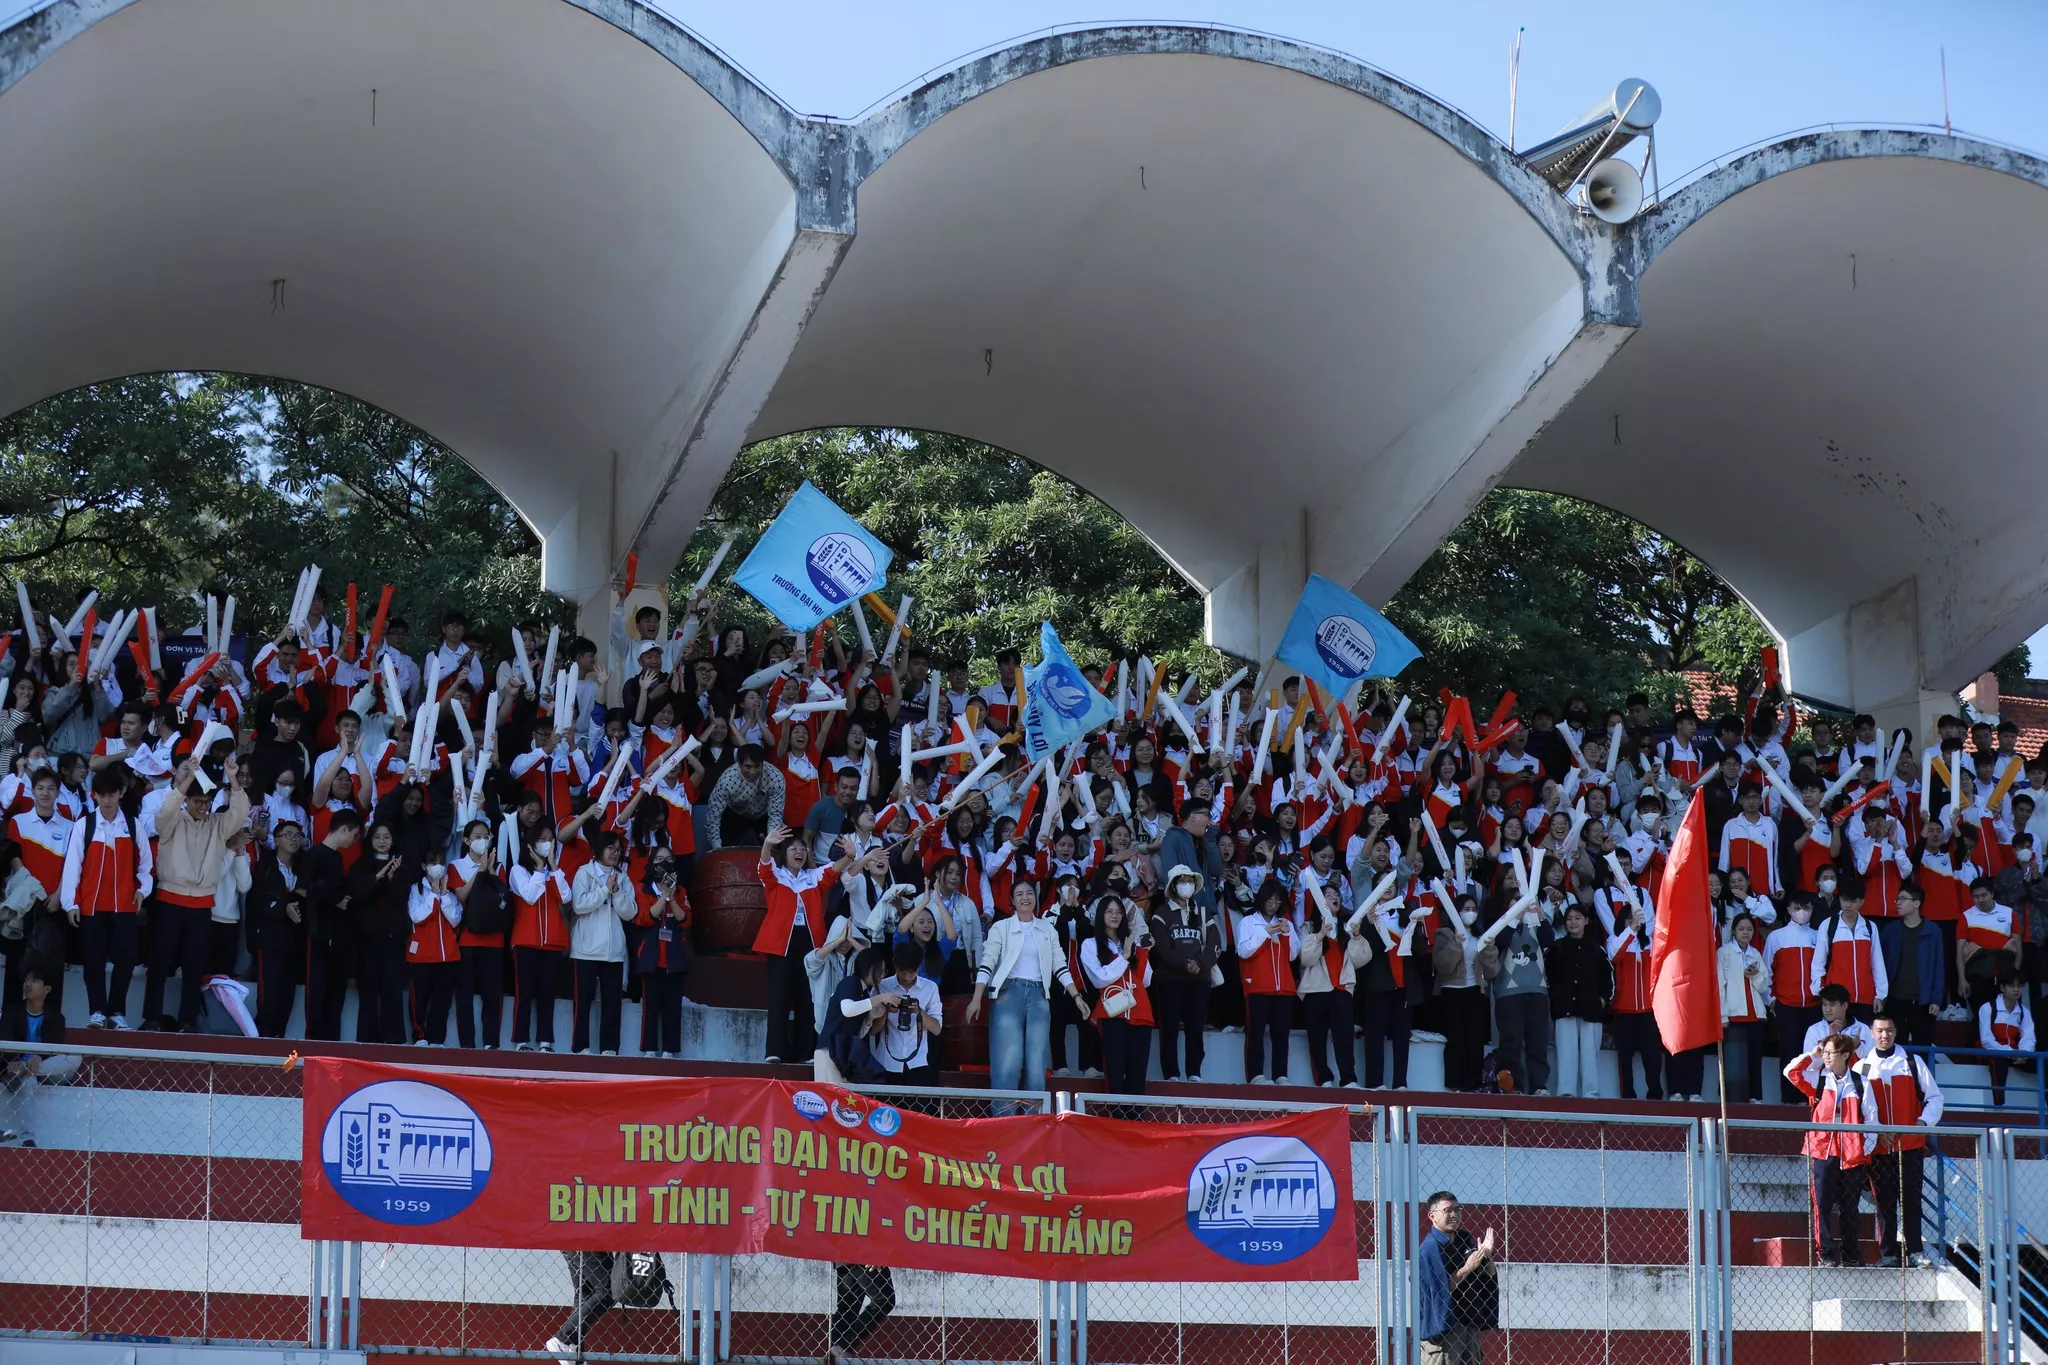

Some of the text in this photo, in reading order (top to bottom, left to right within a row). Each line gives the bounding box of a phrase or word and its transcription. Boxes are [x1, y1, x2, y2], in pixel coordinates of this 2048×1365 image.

[820, 581, 838, 598] 1959
[1328, 657, 1344, 673] 1959
[1030, 731, 1049, 752] LỢI
[619, 1116, 1068, 1202] TRƯỜNG ĐẠI HỌC THUỶ LỢI
[382, 1198, 432, 1213] 1959
[548, 1175, 638, 1224] BÌNH
[648, 1177, 731, 1226] TĨNH
[764, 1187, 807, 1238] TỰ
[811, 1193, 871, 1237] TIN
[903, 1198, 1009, 1252] CHIẾN
[1020, 1203, 1134, 1256] THẮNG
[1238, 1240, 1284, 1252] 1959
[632, 1260, 651, 1277] 22
